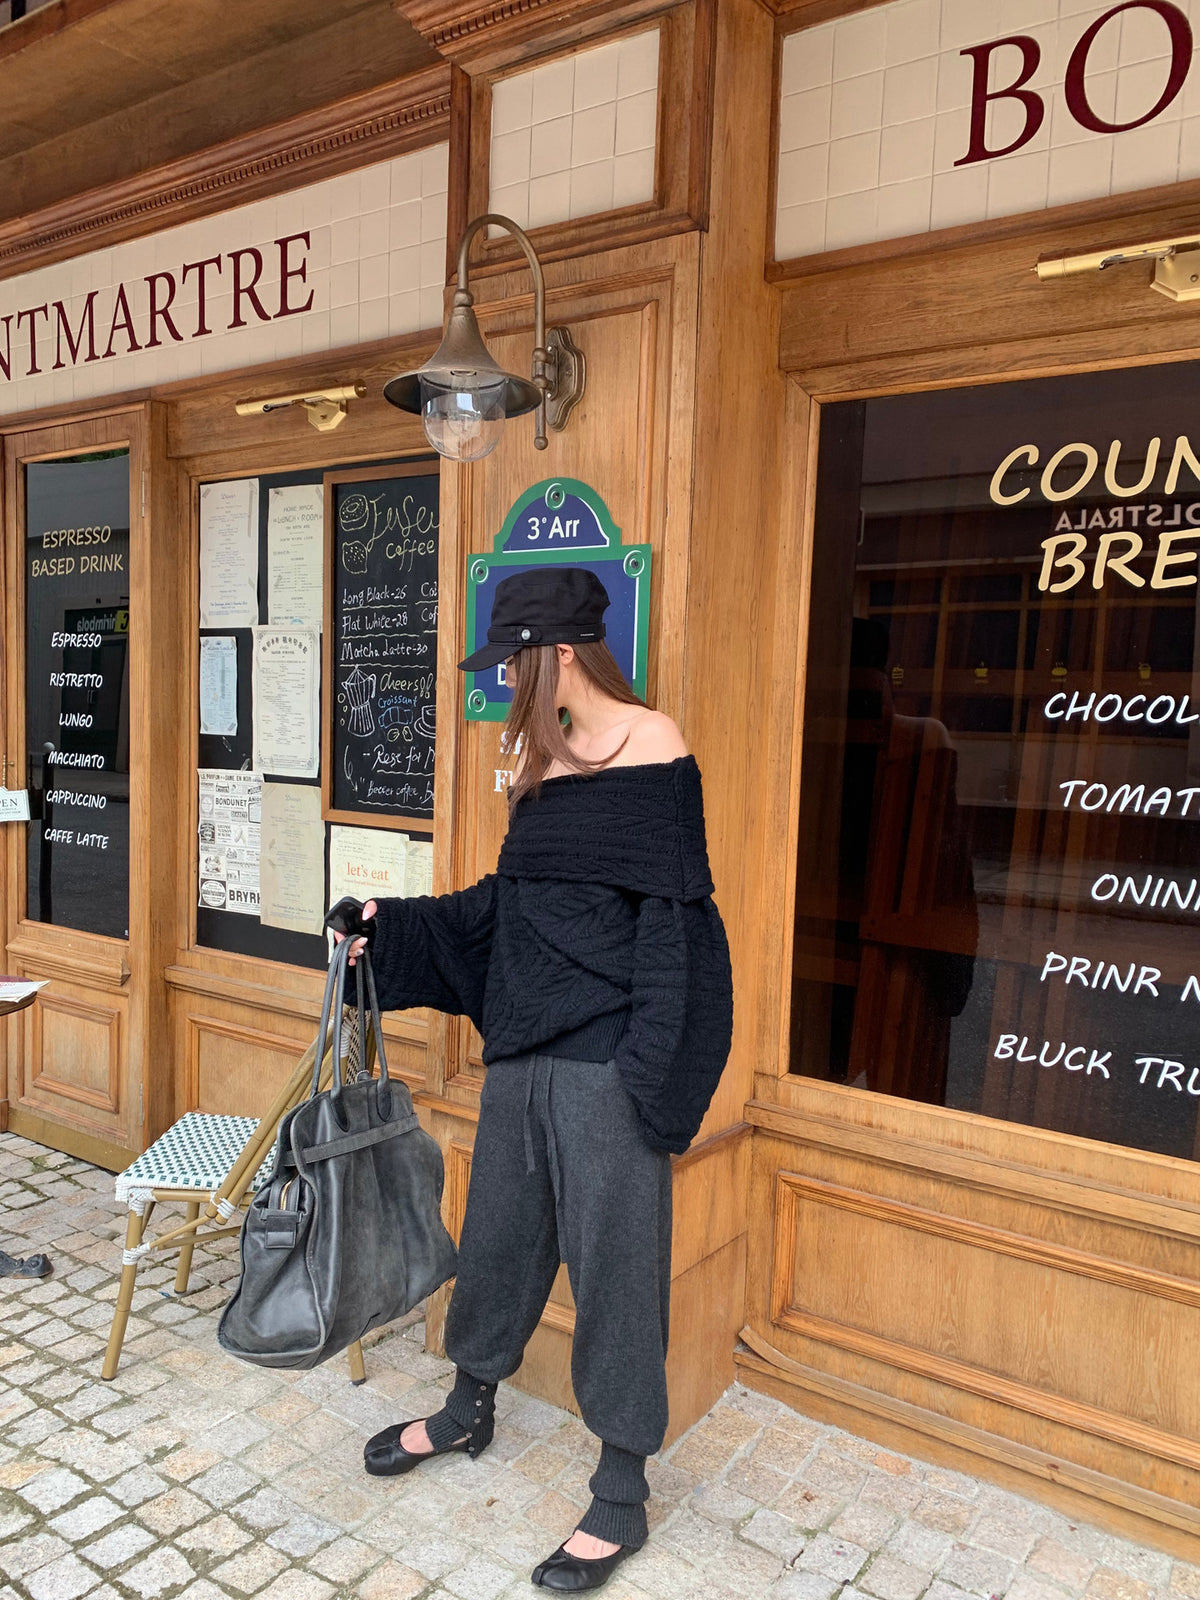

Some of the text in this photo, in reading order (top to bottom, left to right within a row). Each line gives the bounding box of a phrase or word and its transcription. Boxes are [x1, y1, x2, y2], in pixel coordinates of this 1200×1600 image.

[953, 0, 1194, 167] BO
[43, 525, 111, 549] ESPRESSO
[548, 516, 580, 540] Arr
[31, 554, 124, 578] BASED DRINK
[1038, 527, 1200, 594] BRE
[51, 631, 102, 649] ESPRESSO
[49, 672, 103, 689] RISTRETTO
[58, 712, 94, 728] LUNGO
[48, 750, 105, 769] MACCHIATO
[0, 797, 18, 809] EN
[46, 789, 107, 809] CAPPUCCINO
[44, 828, 109, 850] CAFFE LATTE
[346, 861, 390, 881] let's eat
[1041, 951, 1162, 997] PRINR
[993, 1033, 1112, 1080] BLUCK
